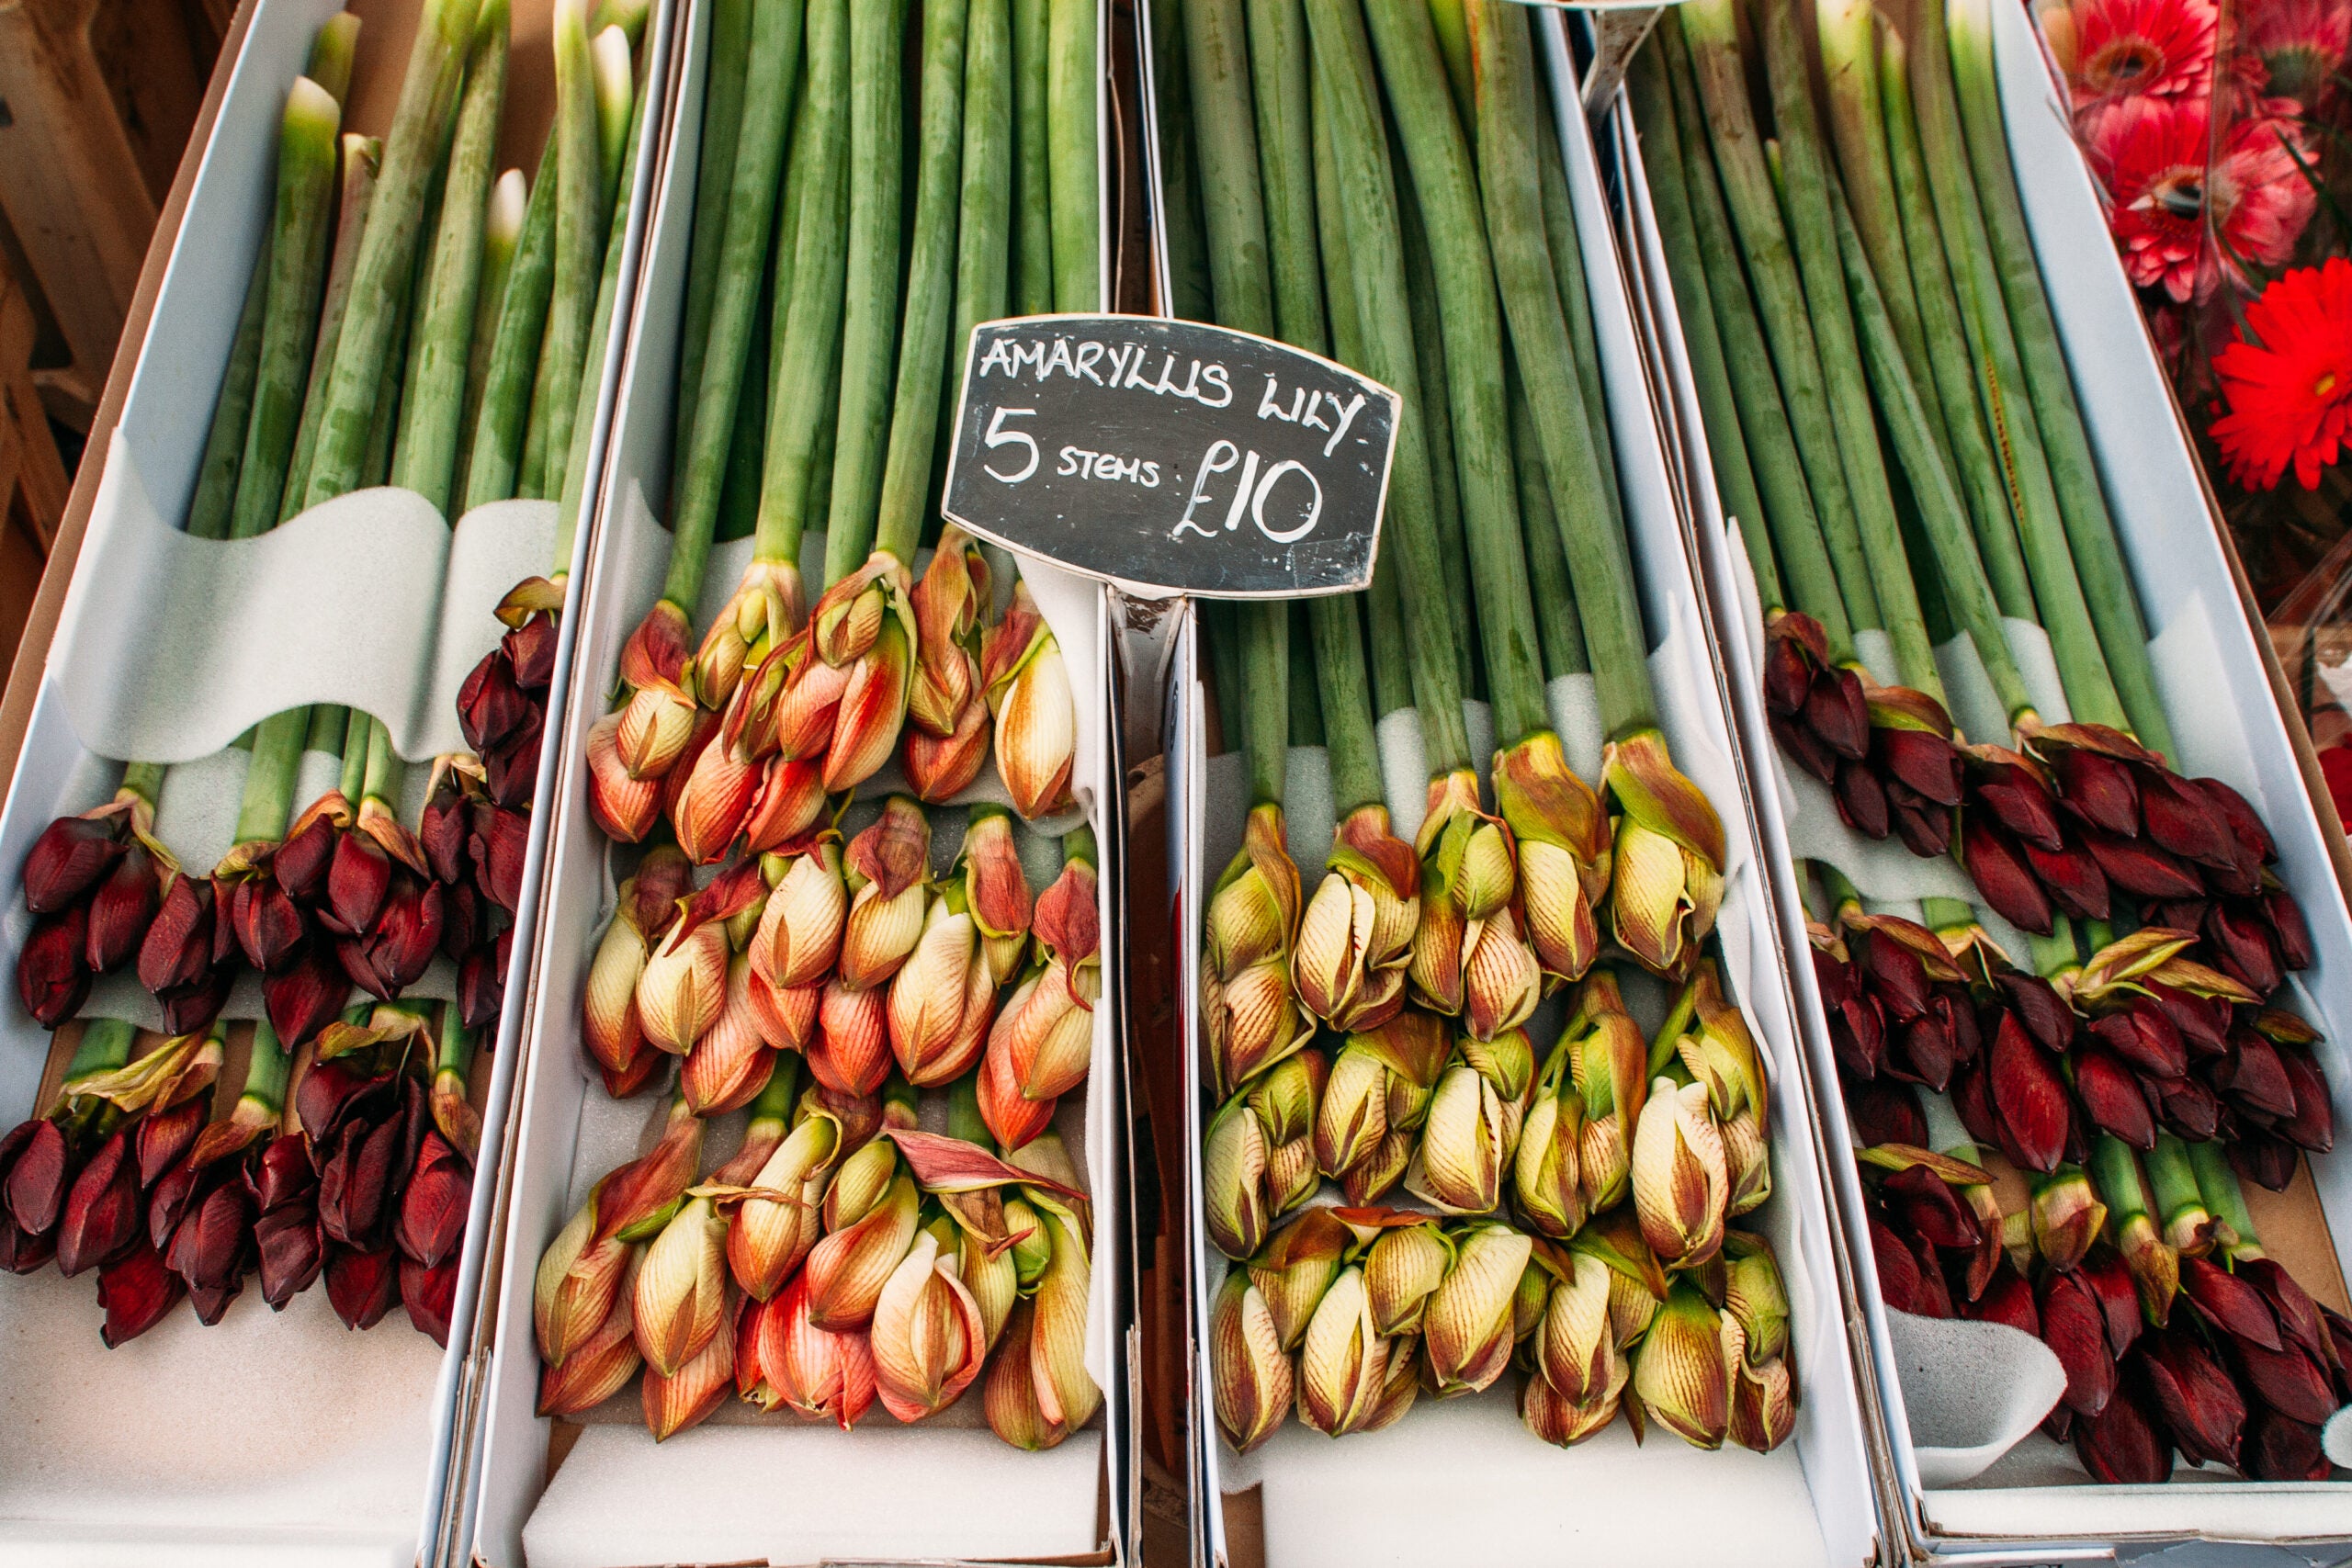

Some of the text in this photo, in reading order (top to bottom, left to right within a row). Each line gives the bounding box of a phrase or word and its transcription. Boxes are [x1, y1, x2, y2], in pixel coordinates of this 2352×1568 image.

[979, 338, 1367, 457] AMARYLLIS LILY
[984, 407, 1323, 544] 5 STEMS £10
